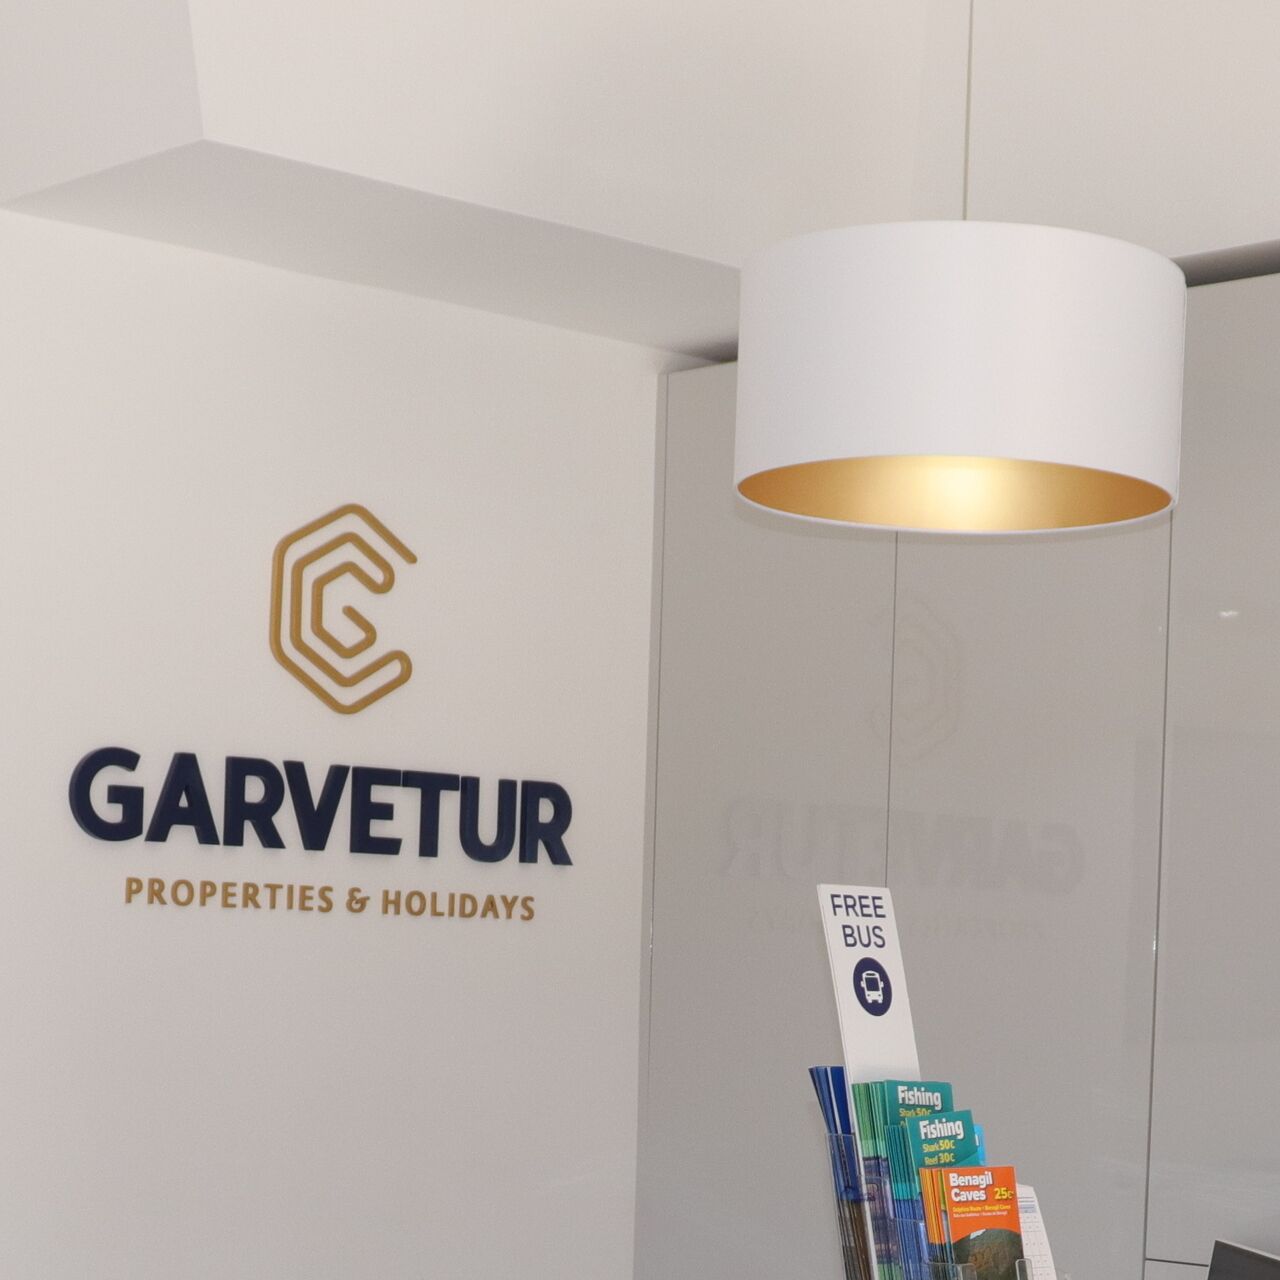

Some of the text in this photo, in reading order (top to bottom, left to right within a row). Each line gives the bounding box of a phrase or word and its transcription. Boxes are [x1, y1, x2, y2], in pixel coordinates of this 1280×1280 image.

[68, 746, 573, 866] GARVETUR
[124, 877, 536, 921] PROPERTIES & HOLIDAYS
[830, 894, 886, 918] FREE
[842, 925, 886, 949] BUS
[897, 1086, 942, 1110] Fishing
[919, 1118, 964, 1139] Fishing
[949, 1171, 993, 1188] Benagil
[951, 1187, 1014, 1202] Caves 25€
